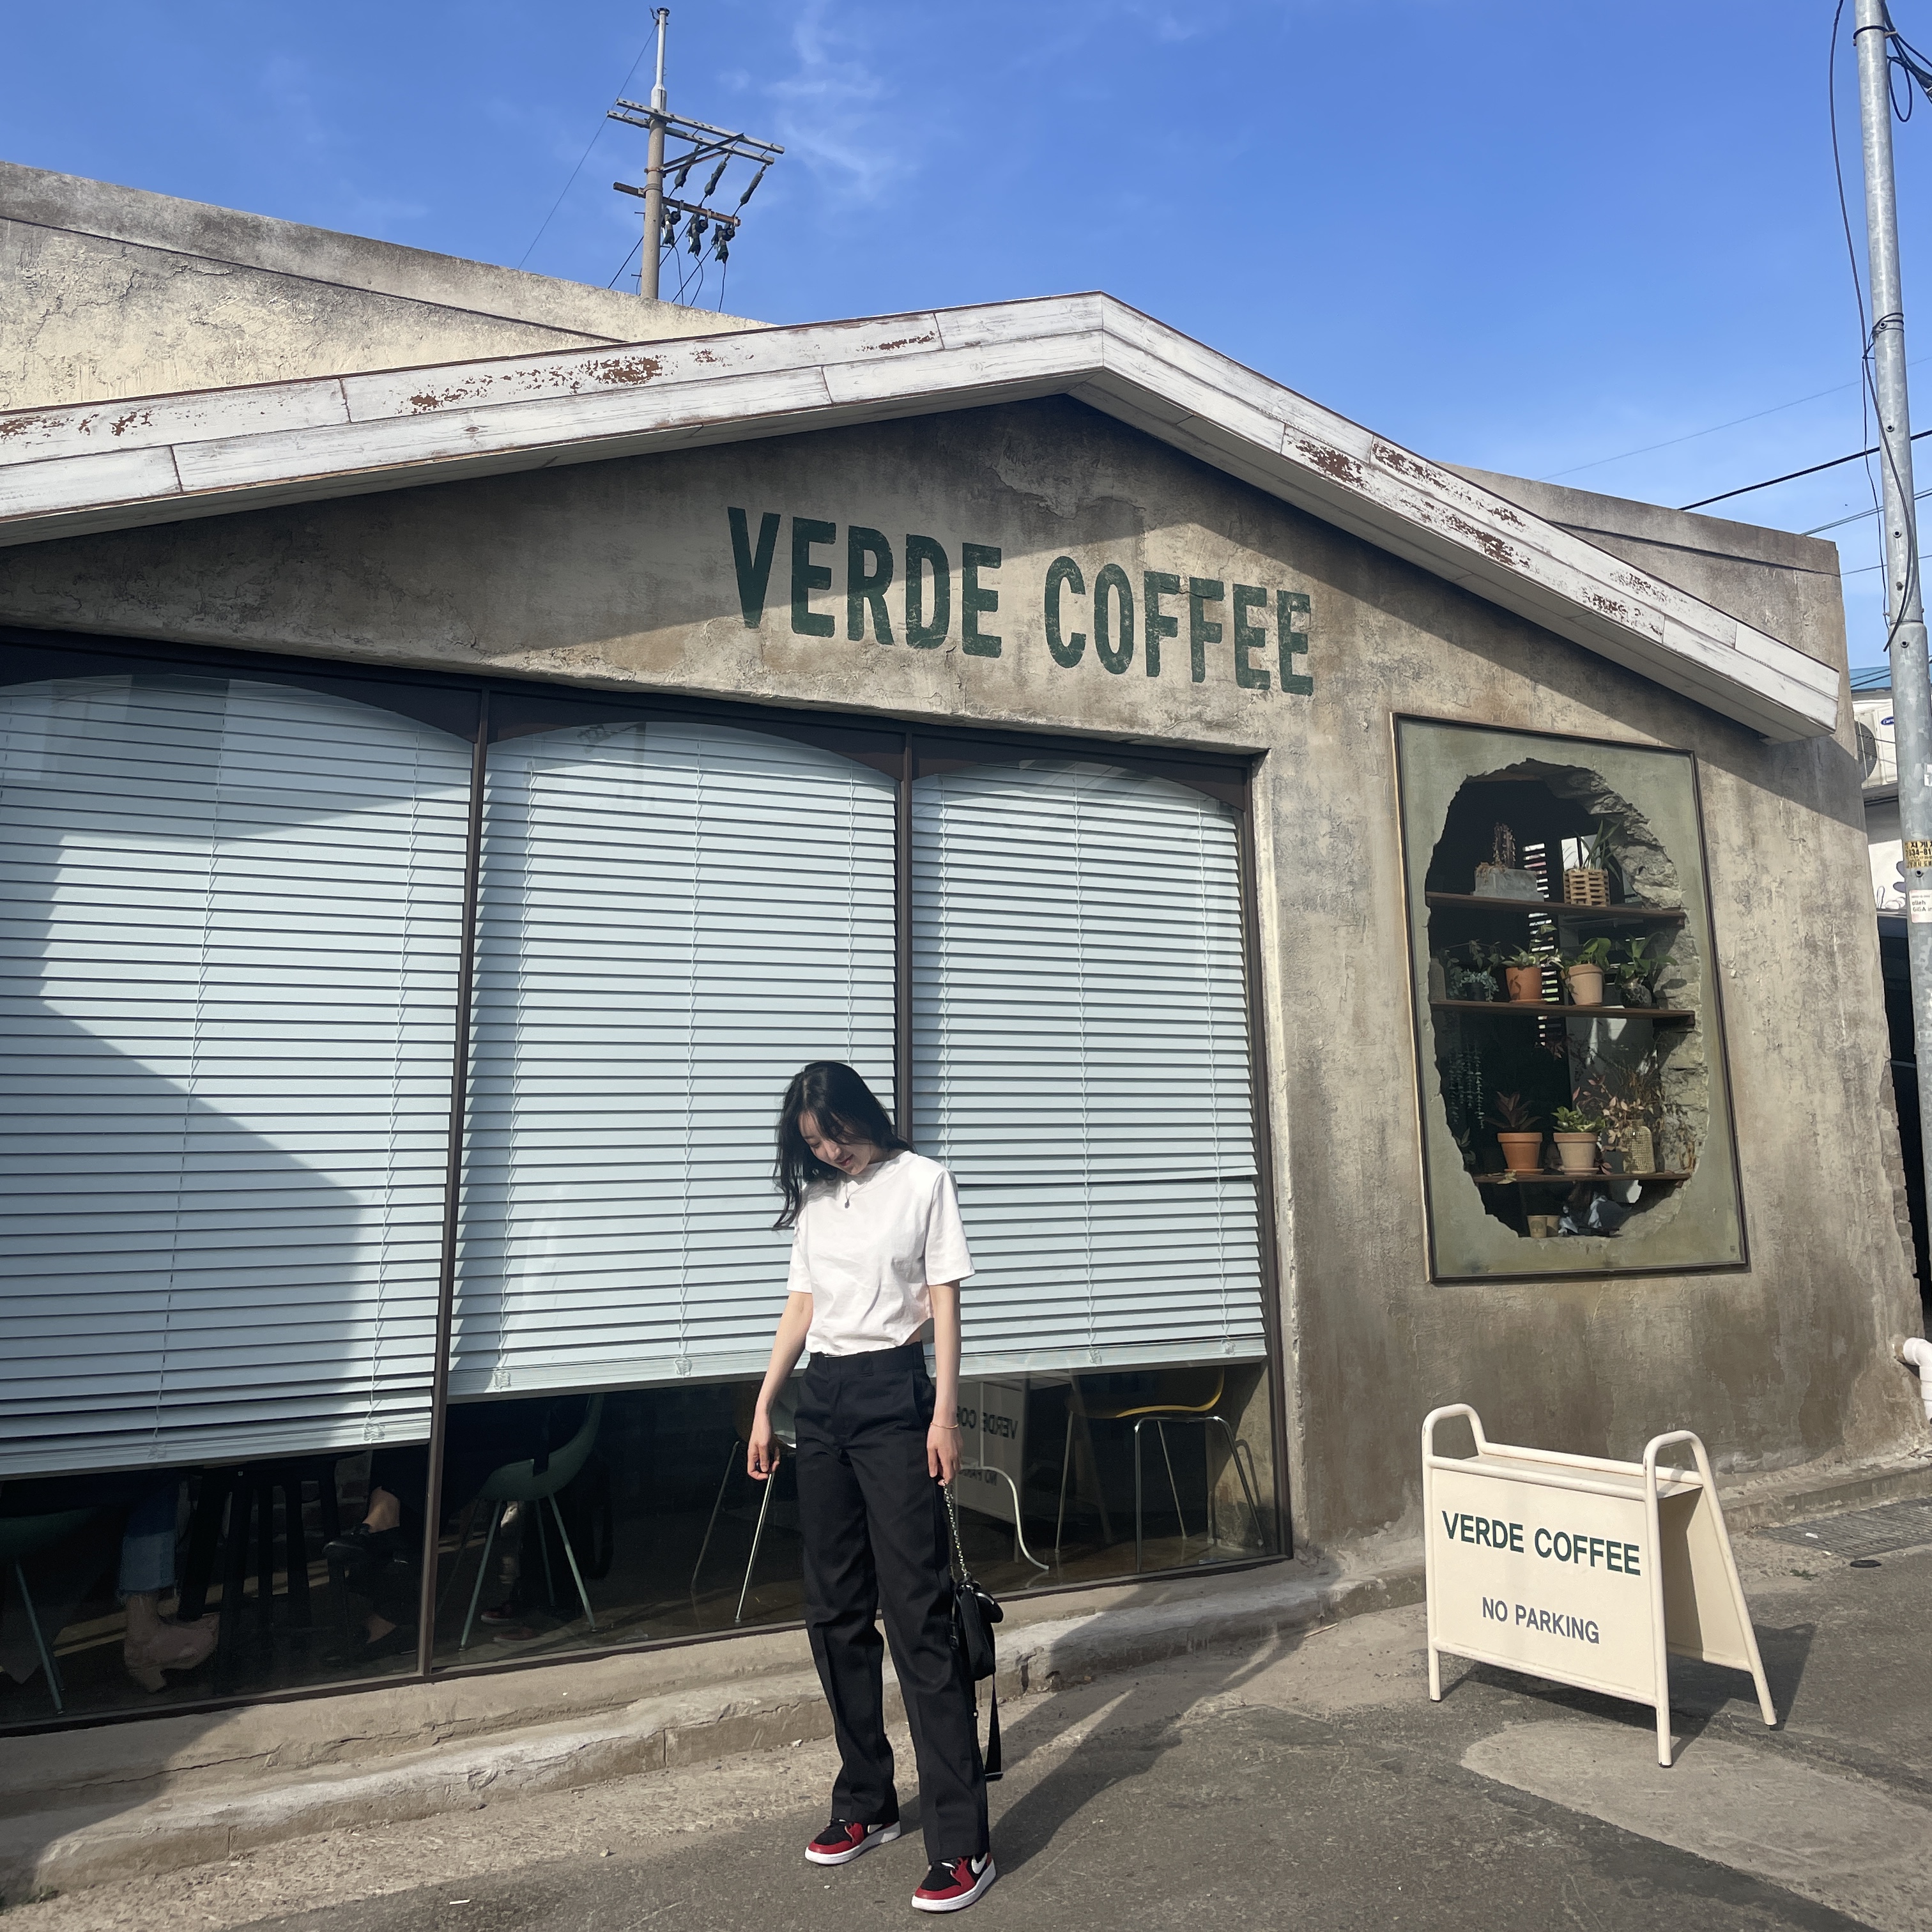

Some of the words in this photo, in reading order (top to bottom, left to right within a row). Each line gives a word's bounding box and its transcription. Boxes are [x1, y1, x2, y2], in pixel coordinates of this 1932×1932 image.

[727, 506, 1002, 659] VERDE
[1045, 556, 1314, 696] COFFEE
[1441, 1510, 1524, 1553] VERDE
[1534, 1528, 1641, 1576] COFFEE
[1482, 1597, 1508, 1622] NO
[1515, 1604, 1600, 1644] PARKING
